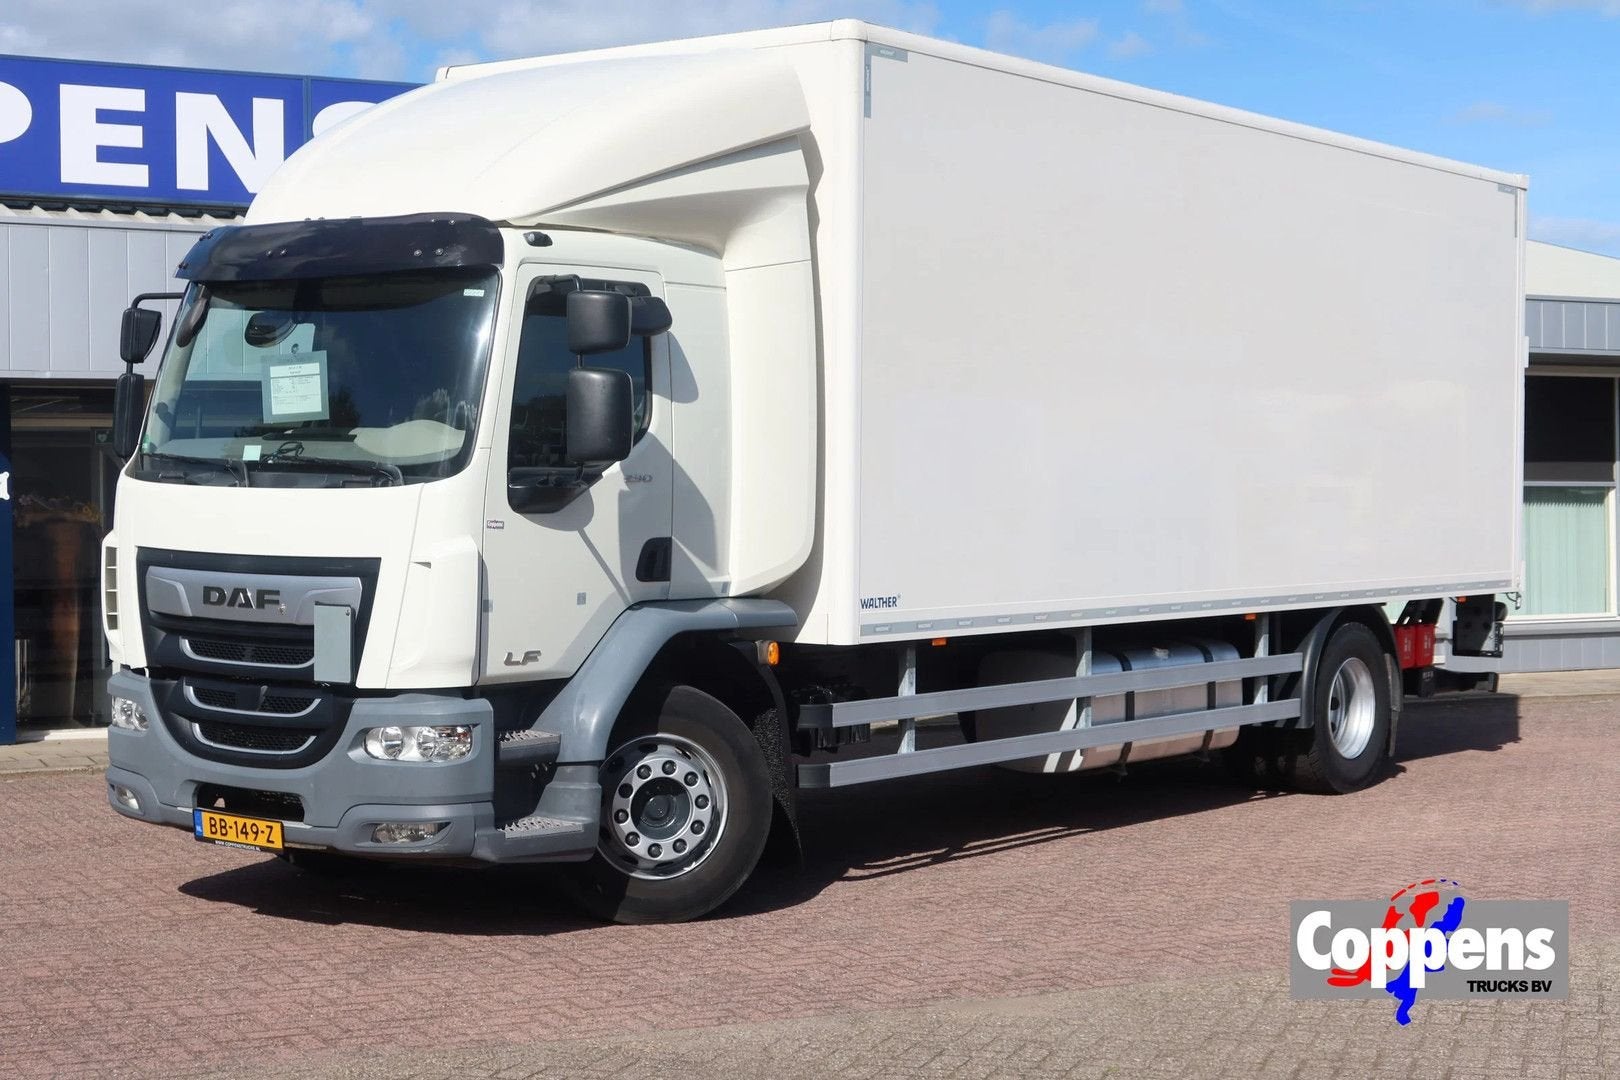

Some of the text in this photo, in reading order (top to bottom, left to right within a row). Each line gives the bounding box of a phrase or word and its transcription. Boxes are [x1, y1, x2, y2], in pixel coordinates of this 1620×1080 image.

[203, 586, 280, 609] DAF
[860, 596, 898, 609] WALTHER
[504, 650, 542, 666] LF
[209, 816, 275, 844] BB-149-Z
